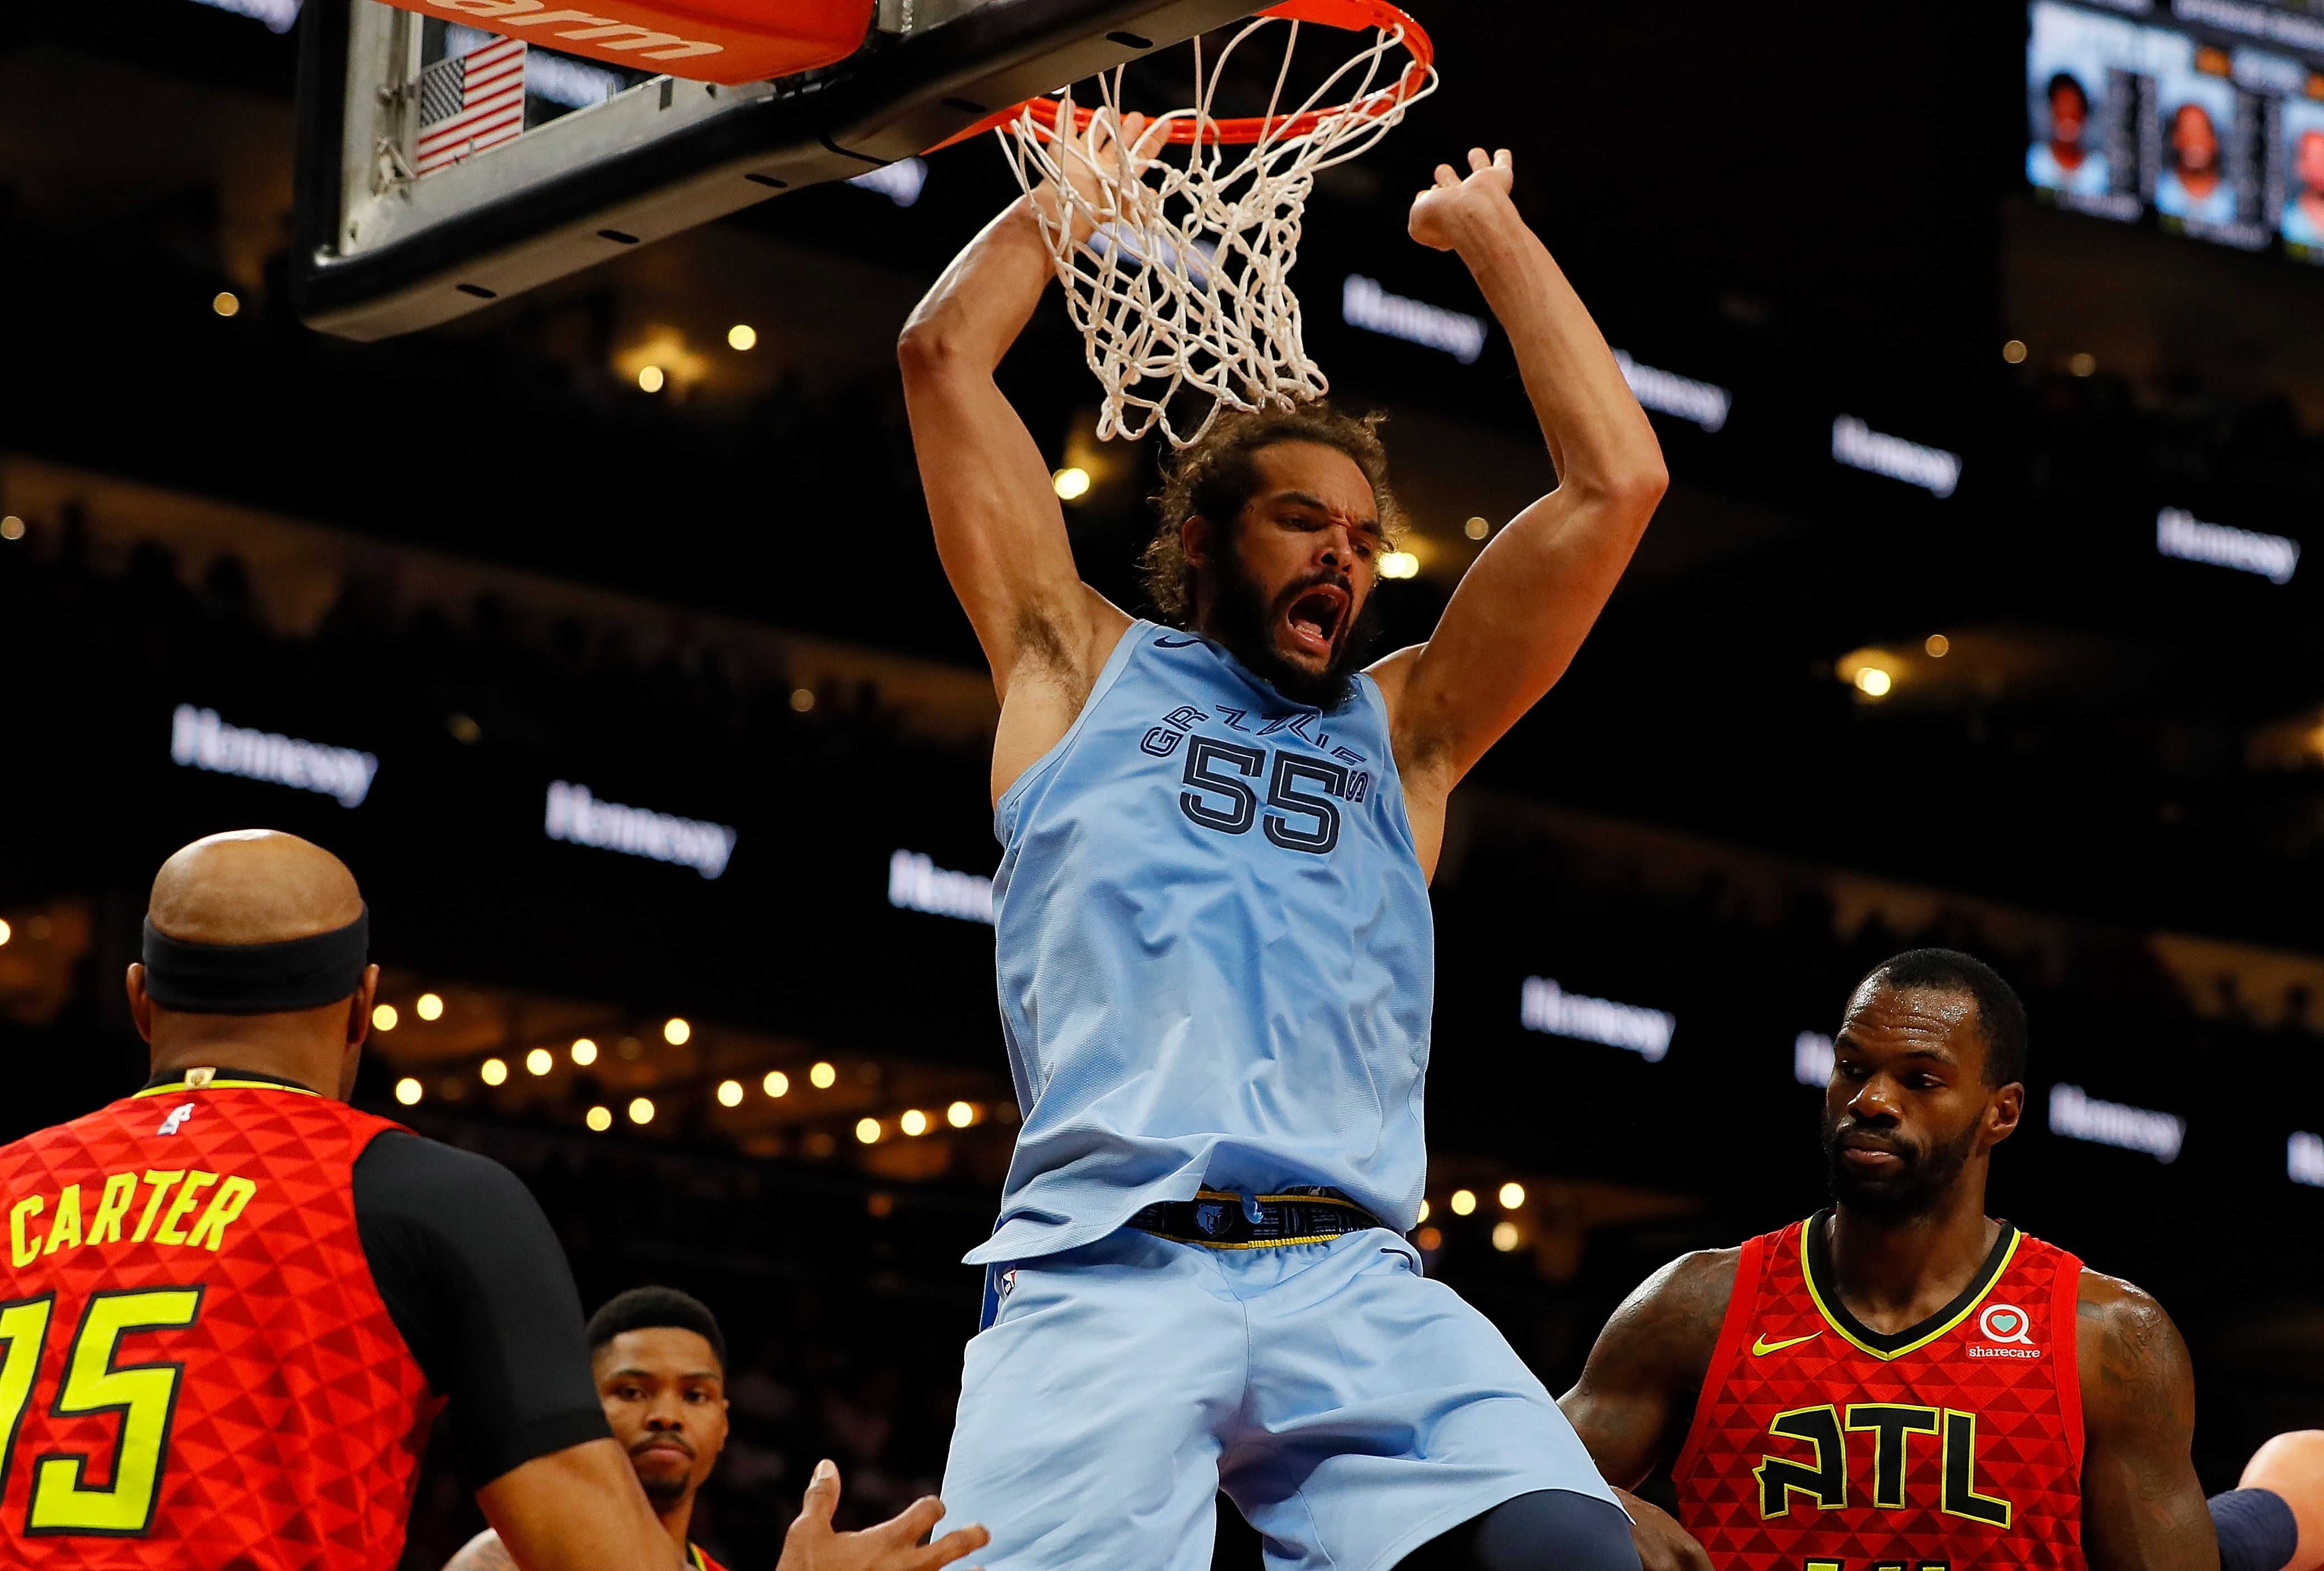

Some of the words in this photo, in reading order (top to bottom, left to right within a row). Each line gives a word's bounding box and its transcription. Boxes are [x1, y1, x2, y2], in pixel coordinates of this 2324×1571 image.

[1179, 734, 1348, 855] 55
[10, 1169, 257, 1268] CARTER
[0, 1284, 205, 1537] 15
[1969, 1346, 2041, 1358] sharecare
[1752, 1403, 2011, 1529] ATL
